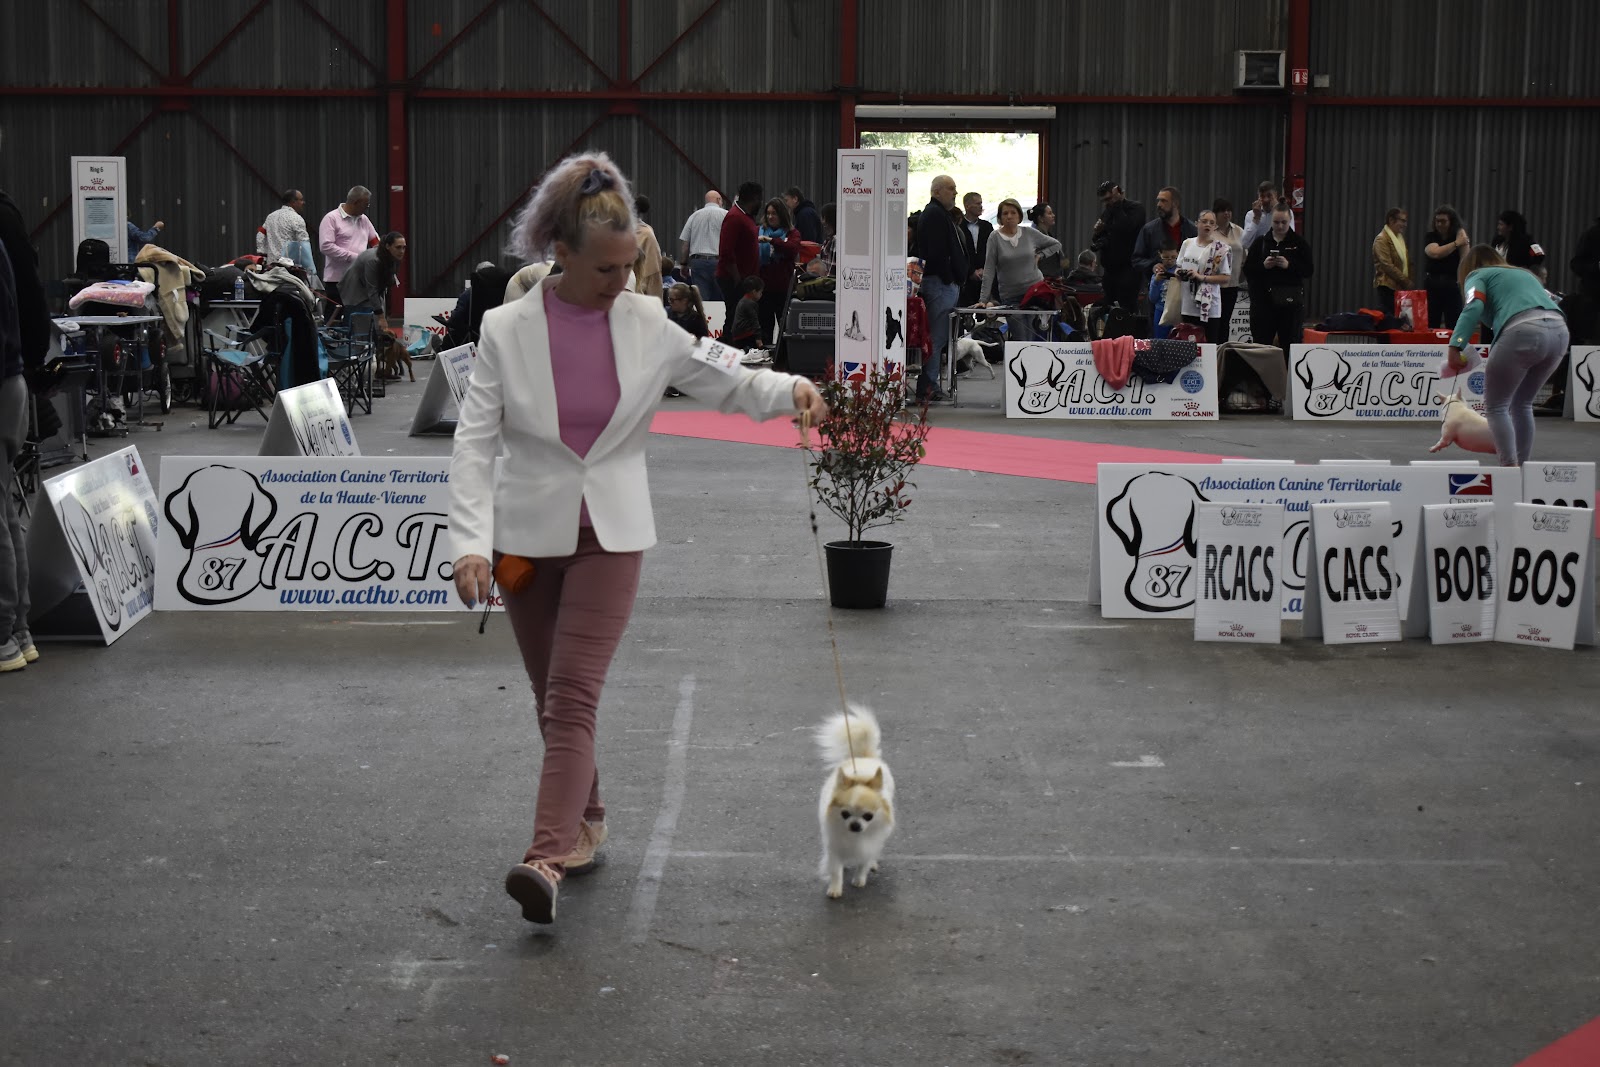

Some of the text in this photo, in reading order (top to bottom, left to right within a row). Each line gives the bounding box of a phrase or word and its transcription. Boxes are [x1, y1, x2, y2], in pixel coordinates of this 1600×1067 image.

[1056, 347, 1094, 355] Association
[1341, 349, 1444, 358] Association Canine Territoriale
[1341, 371, 1442, 409] A.C.T.
[1027, 391, 1052, 408] 87
[1314, 393, 1338, 410] 87
[1068, 405, 1152, 416] www.acthv.com
[1355, 407, 1440, 418] www.acthv.com
[260, 469, 336, 484] Association
[340, 469, 386, 483] Canine
[1199, 476, 1402, 492] Association Canine Territoriale
[300, 490, 427, 504] de la Haute-Vienne
[254, 512, 454, 590] A.C.T.
[198, 557, 247, 591] 87
[1145, 564, 1192, 598] 87
[1204, 544, 1274, 602] RCACS
[1323, 545, 1392, 603] CACS
[1433, 545, 1493, 603] BOB
[1507, 547, 1580, 608] BOS
[280, 585, 448, 604] www.acthv.com
